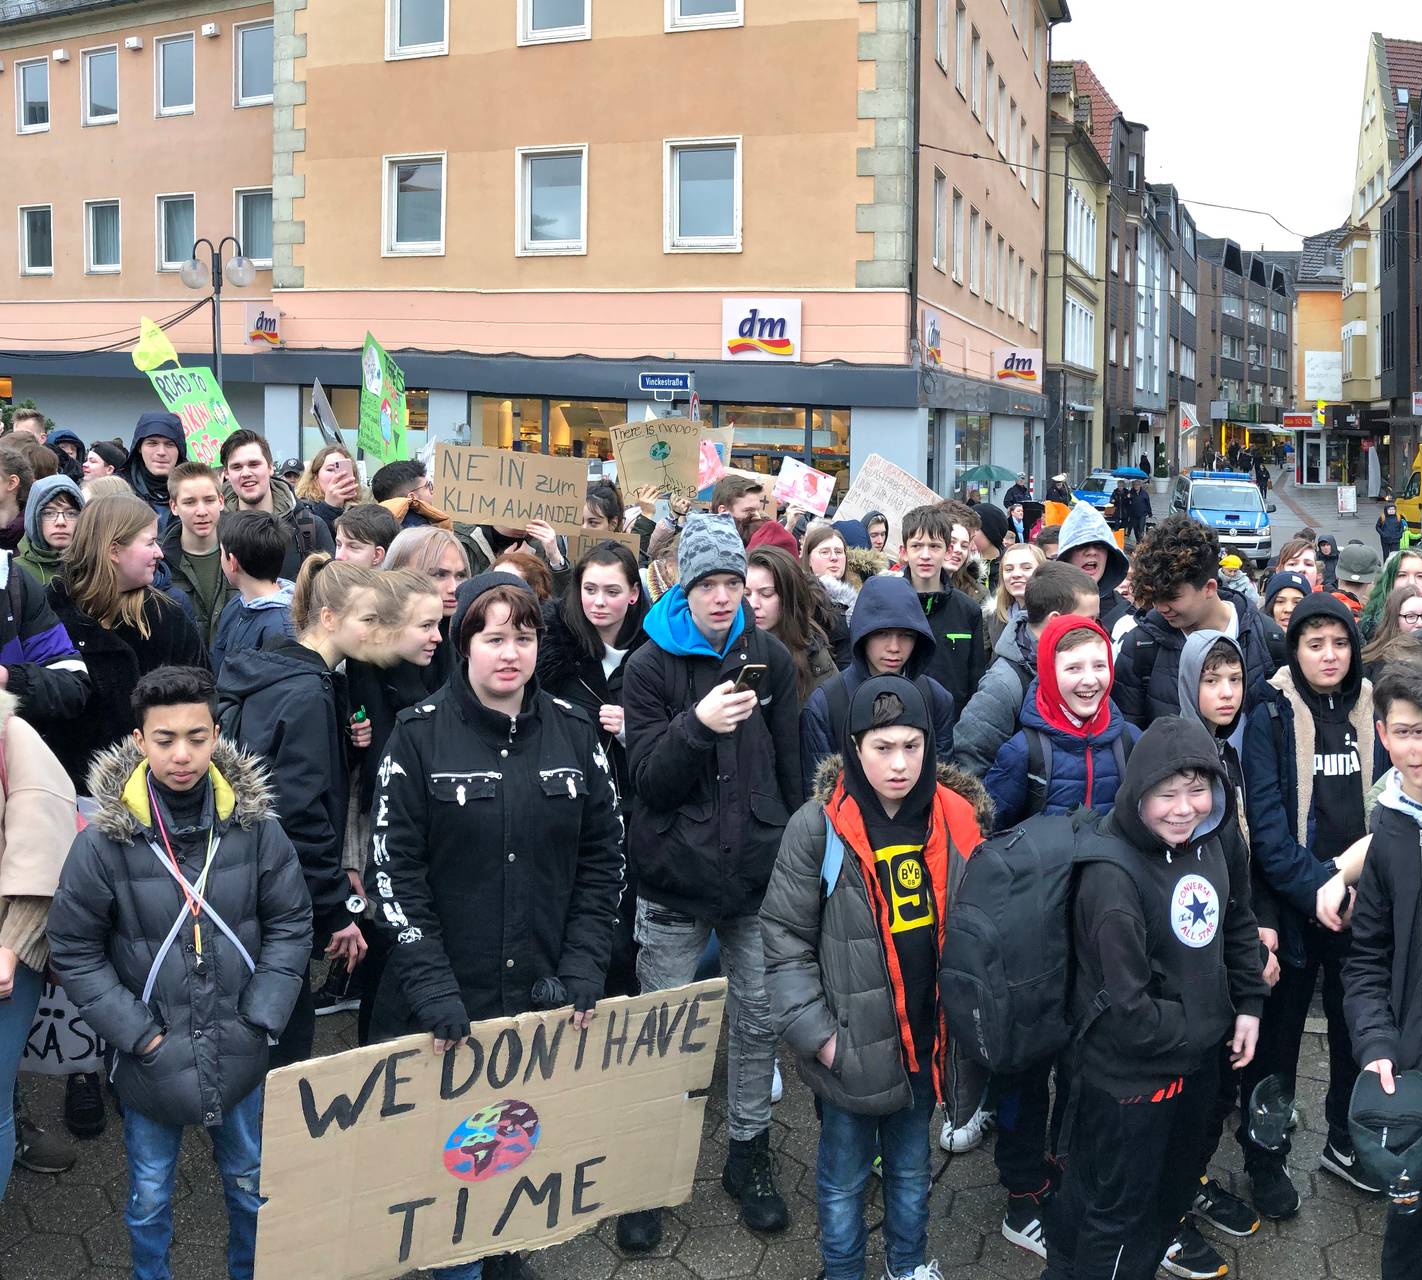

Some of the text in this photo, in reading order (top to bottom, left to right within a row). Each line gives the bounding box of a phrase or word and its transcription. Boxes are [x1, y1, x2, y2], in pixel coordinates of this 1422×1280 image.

[256, 311, 276, 331] dm
[738, 309, 786, 338] dm
[1004, 353, 1032, 371] dm
[155, 372, 207, 404] ROAD TO
[645, 377, 684, 387] Vinckestraße
[611, 425, 642, 440] There
[645, 423, 655, 436] is
[686, 484, 698, 499] B
[444, 486, 583, 527] KLIMAWANDEL
[1215, 518, 1251, 527] POLIZEI
[1313, 750, 1361, 776] PUMA
[901, 863, 920, 881] BVB
[1178, 882, 1212, 906] CONVERSE
[1180, 922, 1215, 941] ALL STAR
[299, 1048, 422, 1138] WE
[601, 990, 724, 1072] HAVE
[388, 1155, 607, 1263] TIME
